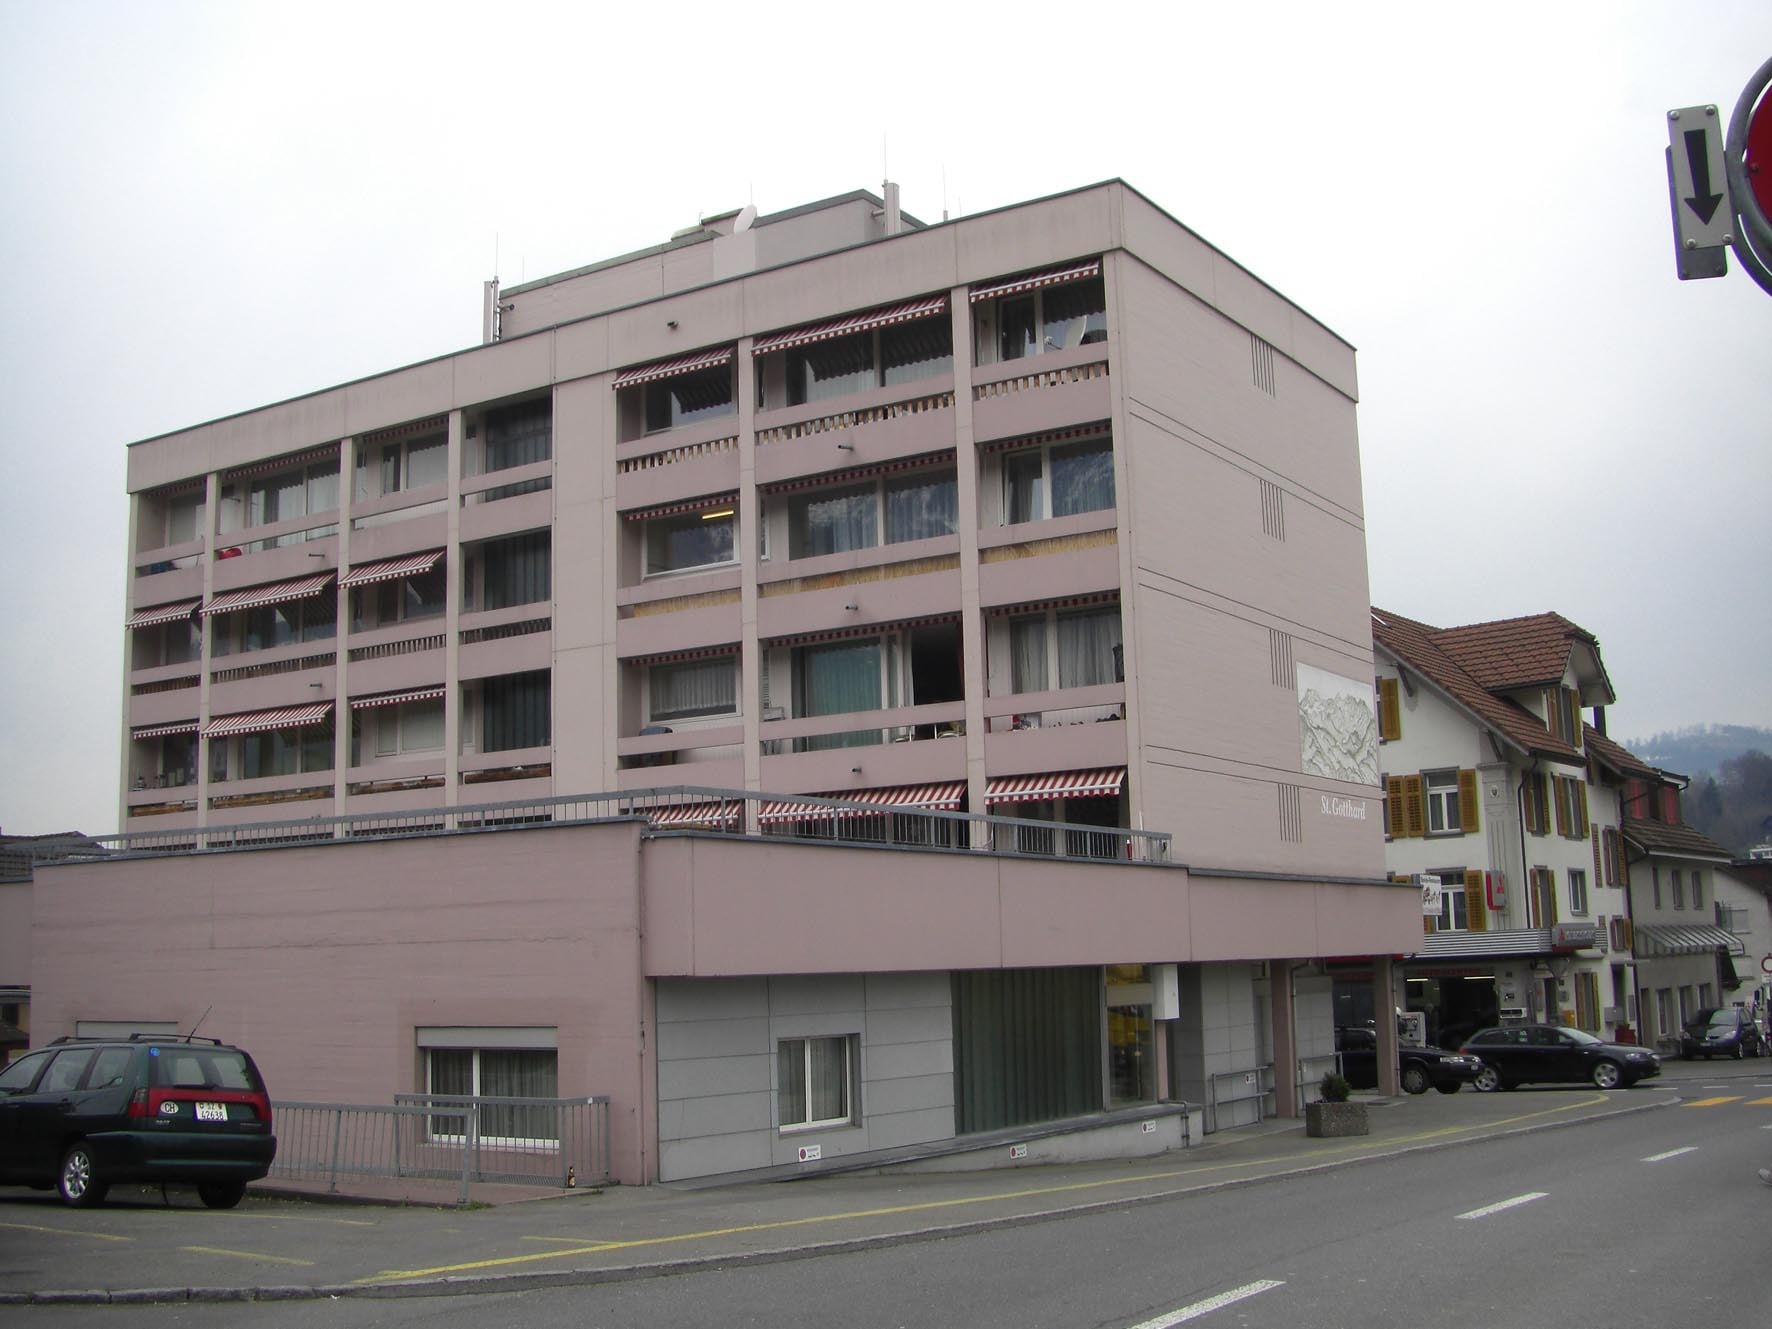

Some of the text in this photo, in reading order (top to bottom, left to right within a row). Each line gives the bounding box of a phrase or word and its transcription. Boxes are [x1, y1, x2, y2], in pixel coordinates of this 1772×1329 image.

[1321, 795, 1366, 820] St. Gotthard
[164, 1103, 176, 1113] CH
[201, 1111, 224, 1120] 42638
